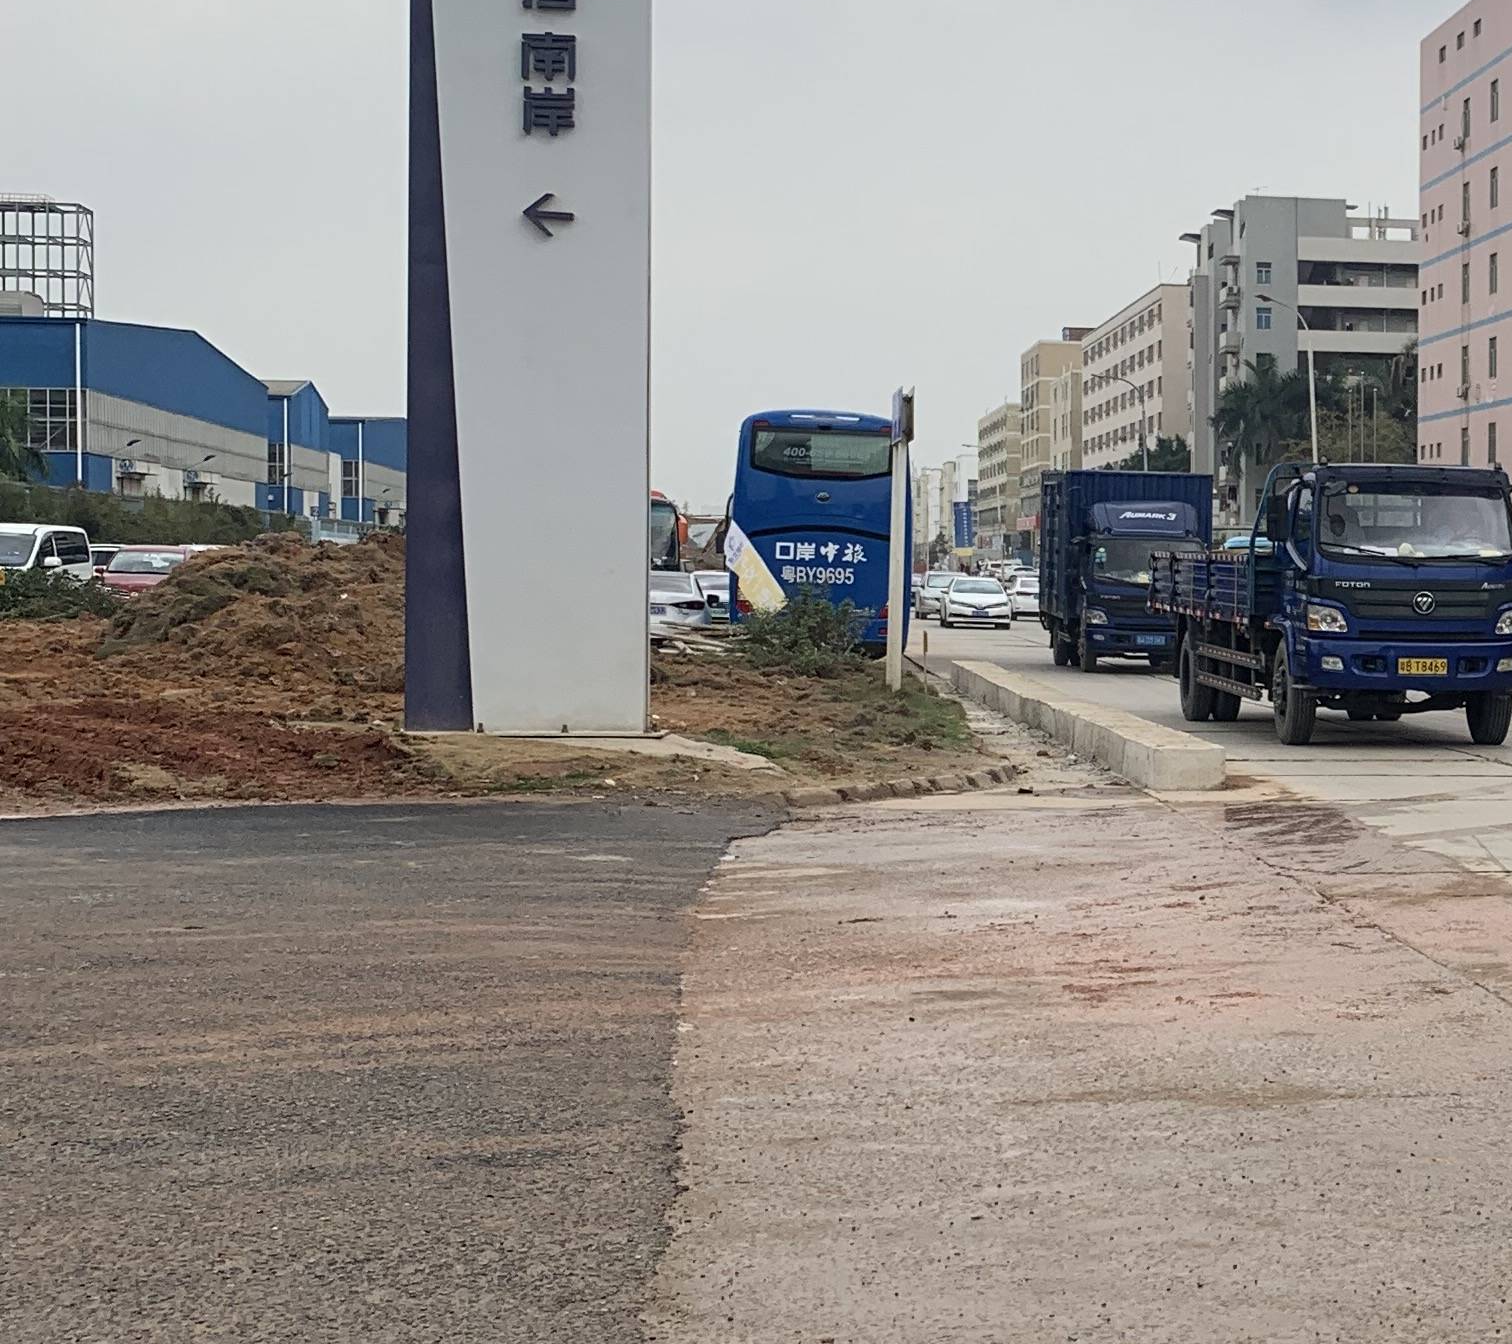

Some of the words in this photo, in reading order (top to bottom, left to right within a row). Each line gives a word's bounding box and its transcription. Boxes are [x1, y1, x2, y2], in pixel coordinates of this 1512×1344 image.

[521, 32, 576, 136] 南岸
[775, 542, 867, 564] 口岸中旅
[781, 565, 855, 585] 粤BY9695
